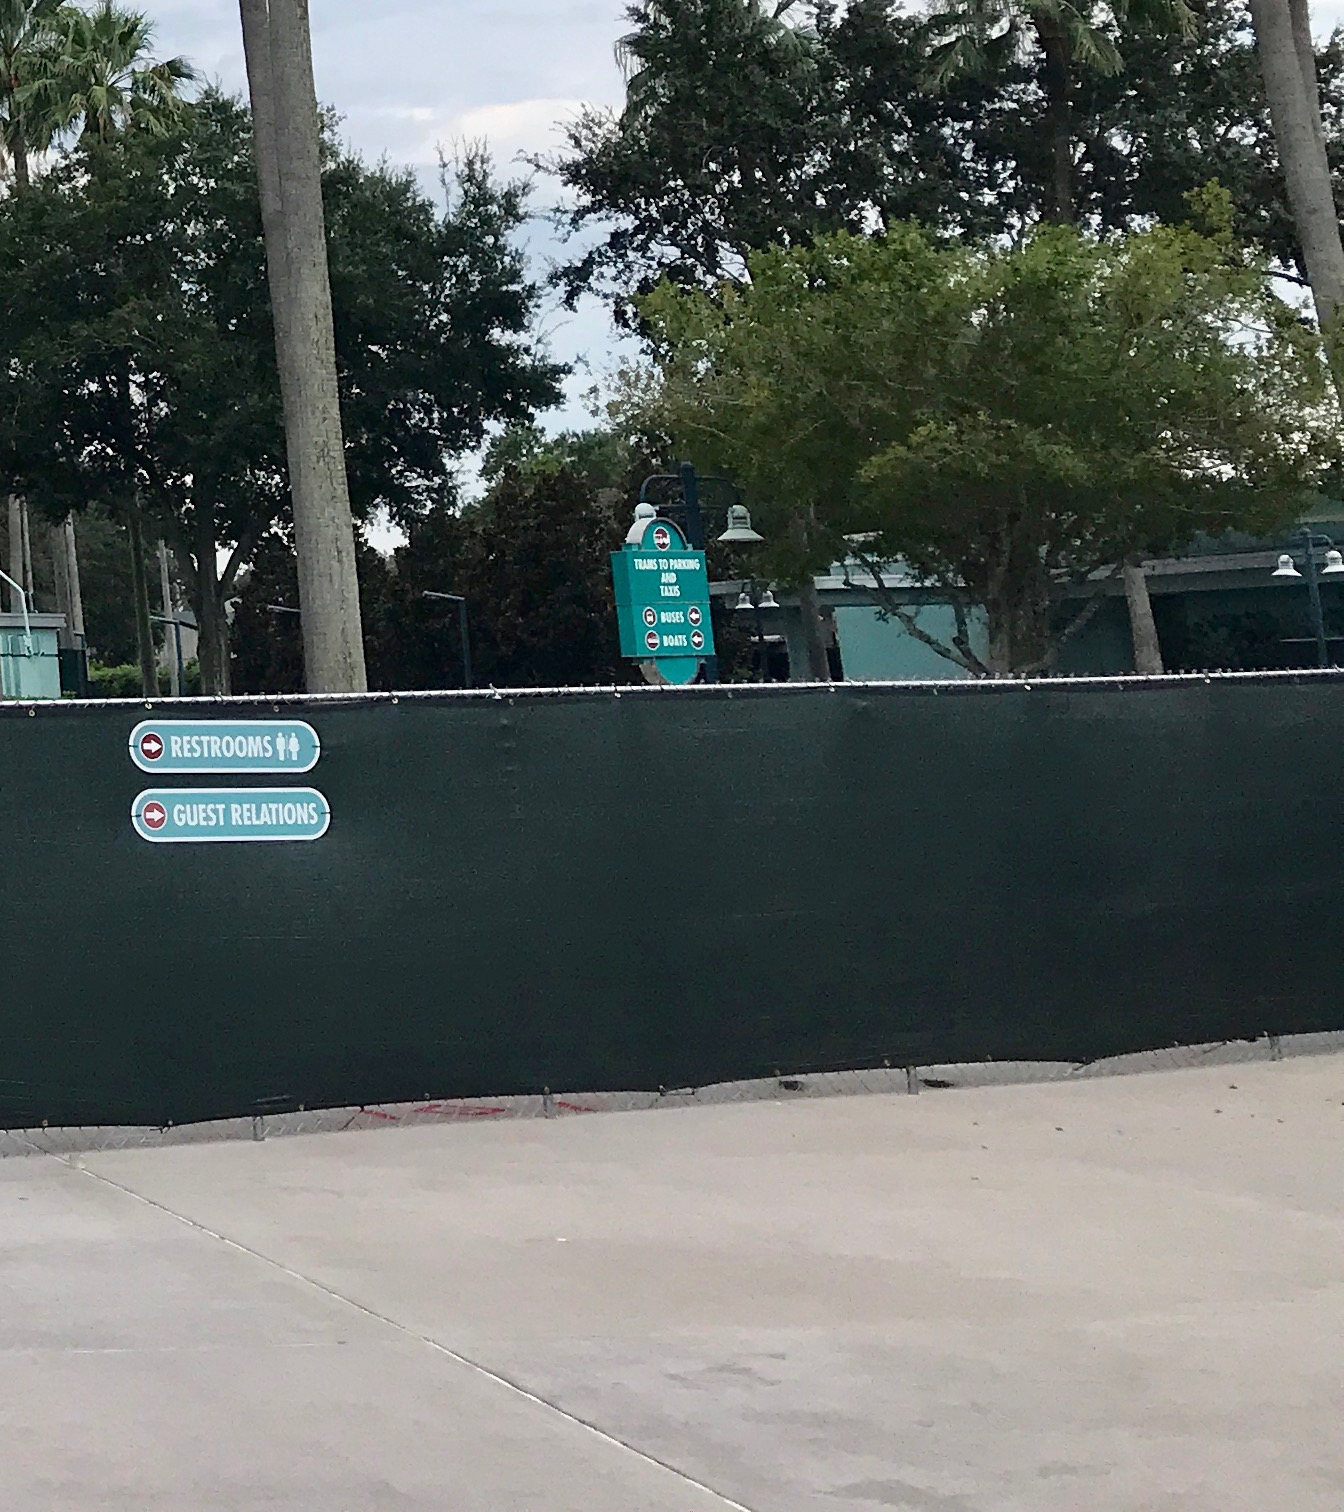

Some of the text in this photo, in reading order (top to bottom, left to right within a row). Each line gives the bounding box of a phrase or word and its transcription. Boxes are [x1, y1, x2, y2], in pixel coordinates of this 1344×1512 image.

[658, 558, 669, 570] TO
[669, 558, 700, 570] PARKING
[661, 572, 677, 584] AND
[659, 585, 681, 597] TAXIS
[660, 611, 685, 623] BUSES
[662, 634, 688, 647] BOATS
[170, 735, 273, 758] RESTROOMS
[173, 802, 319, 826] GUEST RELATIONS
